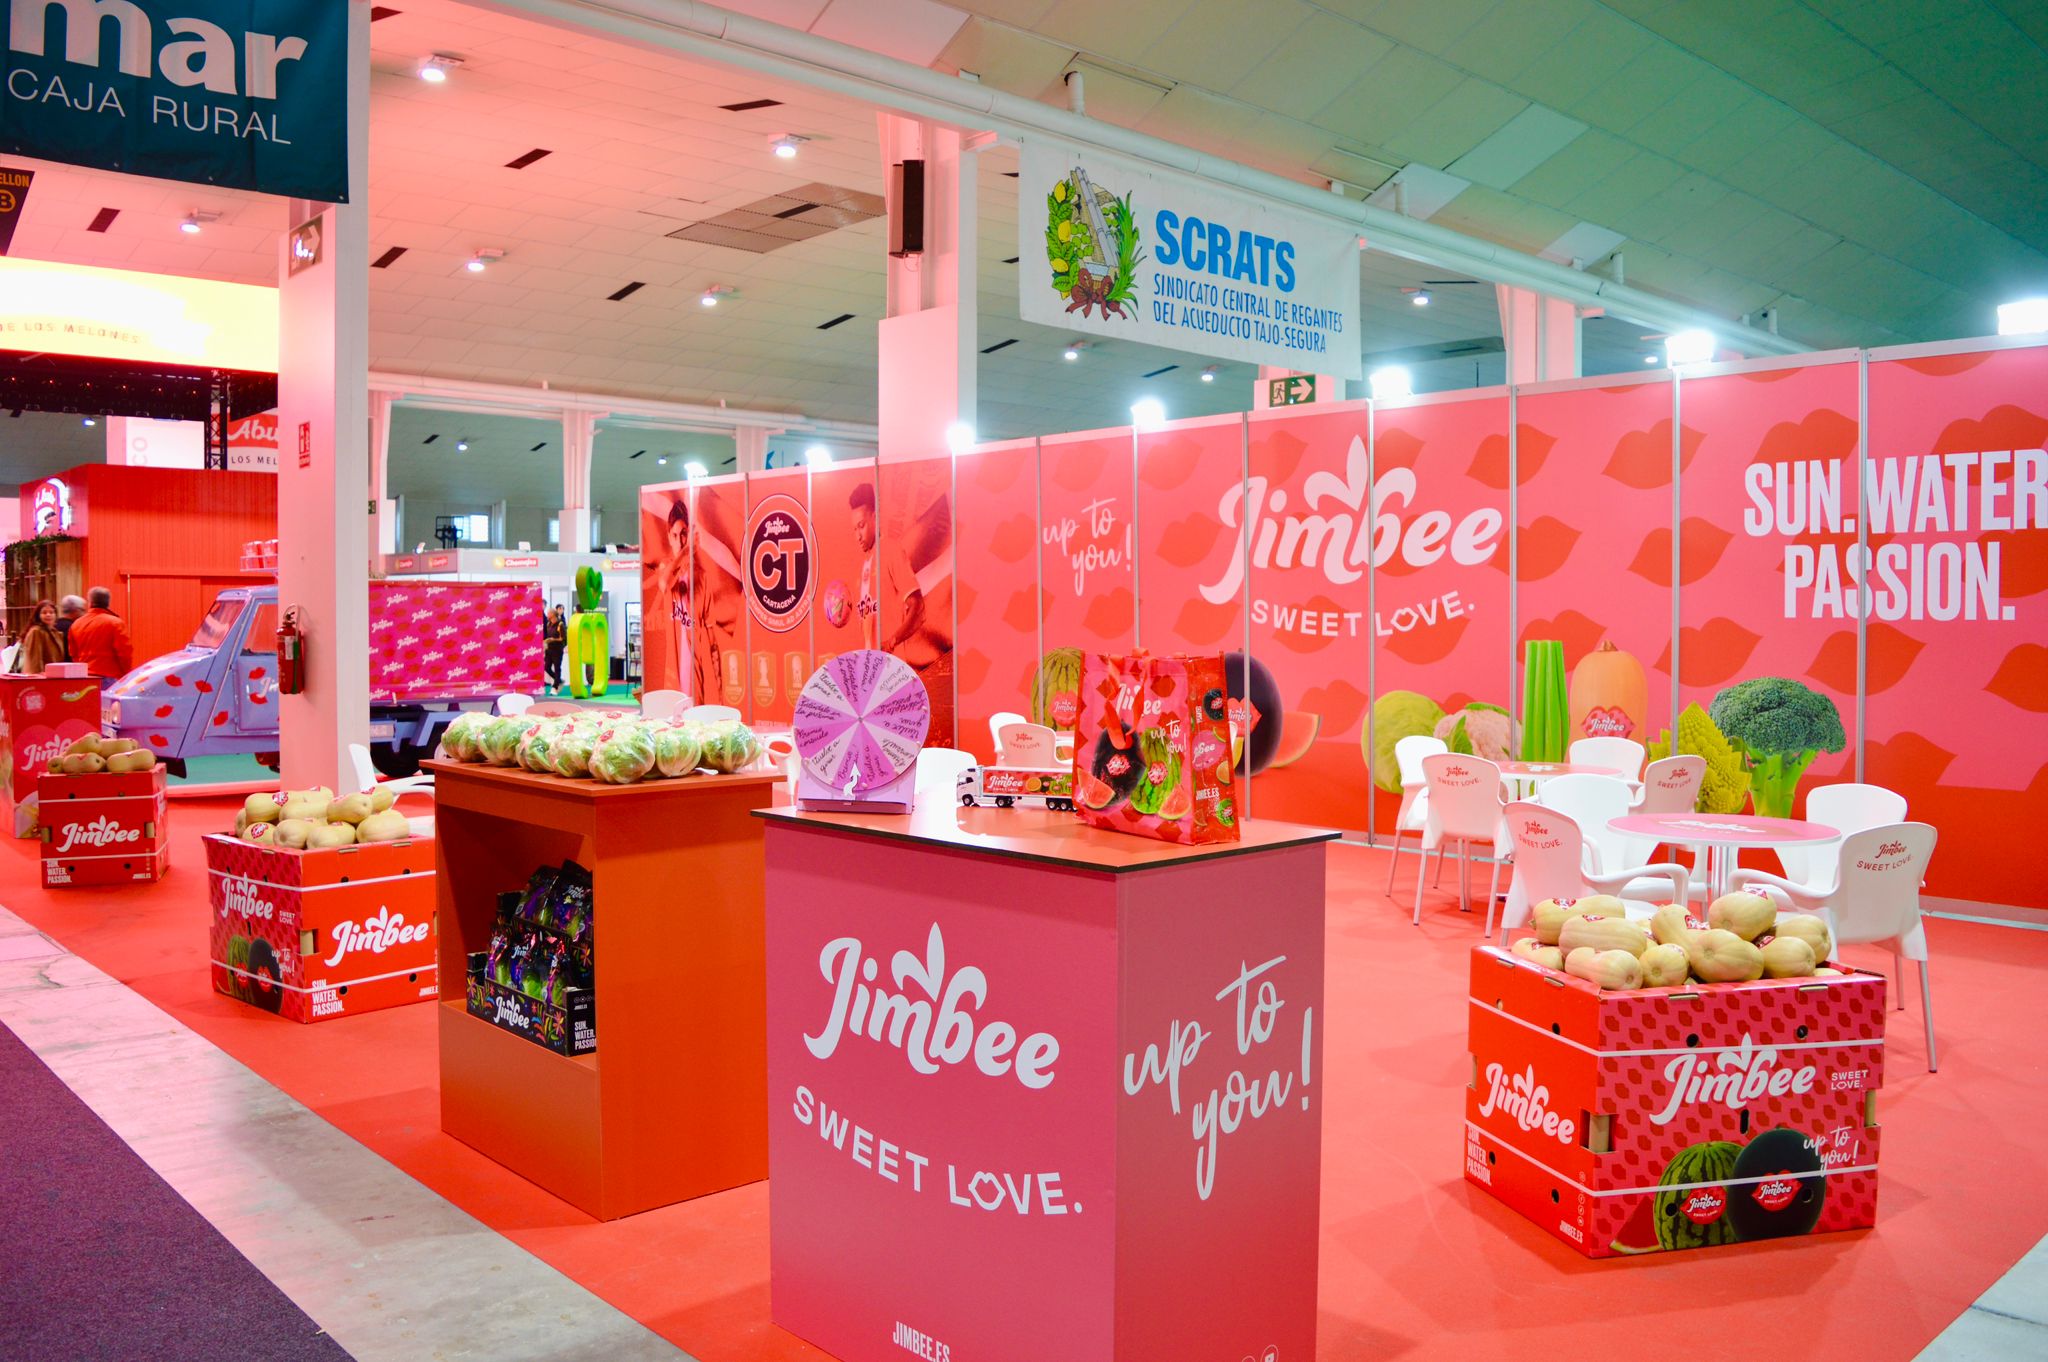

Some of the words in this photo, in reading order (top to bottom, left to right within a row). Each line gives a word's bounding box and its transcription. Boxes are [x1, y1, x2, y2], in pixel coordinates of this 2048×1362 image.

[9, 0, 308, 100] mar
[8, 69, 126, 117] CAJA
[153, 96, 291, 144] RURAL
[1155, 209, 1296, 293] SCRATS
[1154, 273, 1218, 307] SINDICATO
[1222, 288, 1270, 318] CENTRAL
[1274, 299, 1288, 322] DE
[1292, 303, 1343, 333] REGANTES
[1153, 300, 1176, 326] DEL
[1181, 307, 1250, 339] ACUEDUCTO
[1254, 320, 1327, 353] TAJO-SEGURA
[231, 455, 250, 464] LOS
[1744, 459, 1856, 536] SUN.
[764, 517, 790, 538] Jimbee
[1042, 517, 1080, 557] up
[1082, 498, 1117, 541] to
[1198, 434, 1502, 605] Jimbee
[753, 538, 804, 591] CT
[1071, 524, 1133, 596] you!
[1785, 541, 2016, 621] PASSION.
[762, 595, 796, 609] CARTAGENA
[1249, 598, 1362, 637] SWEET
[1373, 590, 1475, 637] LOVE.
[1116, 683, 1161, 717] Jiee
[1151, 727, 1167, 746] up
[1166, 720, 1181, 738] to
[1588, 716, 1626, 733] Jimbee
[988, 773, 1023, 788] Jimbee
[56, 815, 140, 853] Jimbee
[1875, 840, 1907, 858] Jimbee
[1857, 860, 1890, 871] SWEET
[221, 871, 274, 919] Jimbee
[324, 904, 430, 967] Jimbee
[312, 989, 338, 1005] WATER.
[312, 1000, 345, 1017] PASSION.
[493, 995, 530, 1029] Jimbee
[803, 921, 1060, 1089] Jimbee
[574, 1021, 588, 1031] SUN.
[1123, 1018, 1212, 1116] up
[1215, 955, 1287, 1056] to
[1648, 1031, 1816, 1126] Jimbee
[1831, 1069, 1869, 1081] SWEET
[1831, 1080, 1864, 1090] LOVE.
[1192, 1006, 1313, 1201] you!
[1478, 1063, 1575, 1145] Jimbee
[793, 1085, 929, 1193] SWEET
[948, 1164, 1083, 1216] LOVE.
[1803, 1135, 1828, 1157] up
[1829, 1126, 1854, 1148] to
[1820, 1139, 1859, 1177] you!
[1686, 1193, 1722, 1213] Jimbee
[1758, 1180, 1792, 1199] Jimbee
[892, 1320, 951, 1362] JIMBEE.ES
